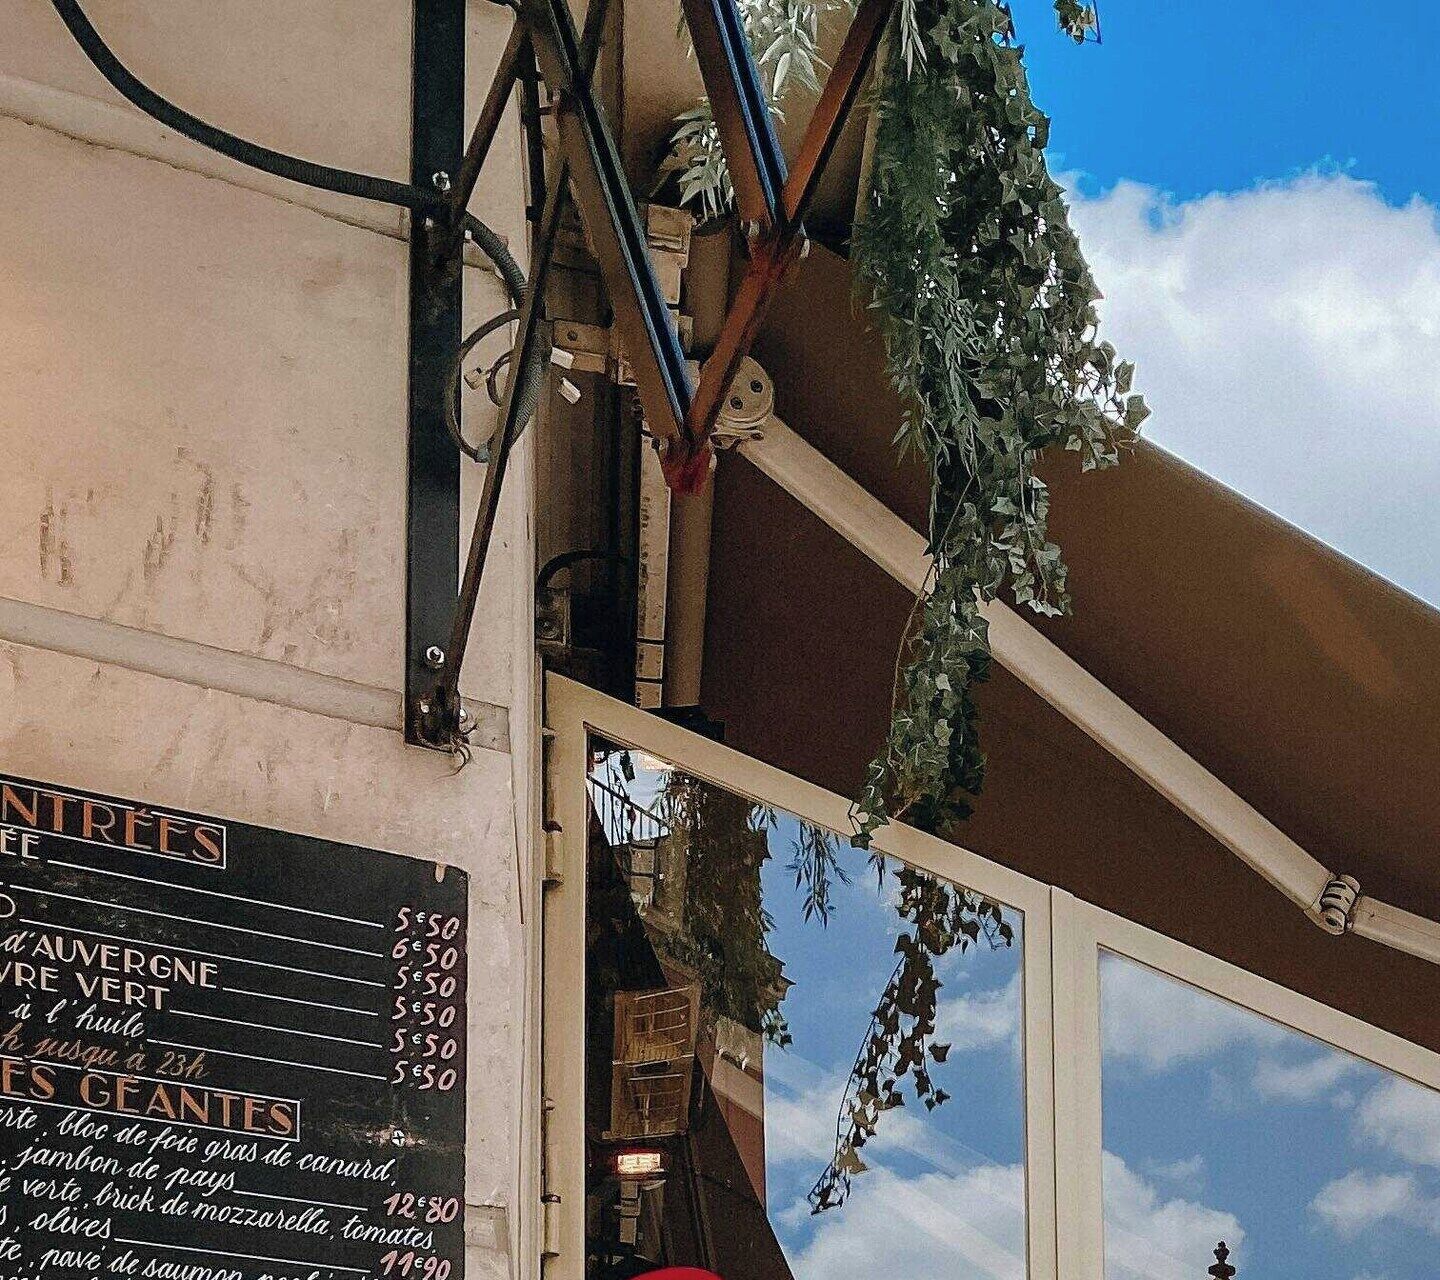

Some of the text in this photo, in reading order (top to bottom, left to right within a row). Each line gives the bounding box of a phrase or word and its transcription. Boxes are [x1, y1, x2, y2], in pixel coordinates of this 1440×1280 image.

[9, 993, 31, 1020] à
[75, 972, 170, 1010] VERT
[156, 1051, 209, 1079] 23h
[80, 1073, 294, 1135] GÉANTES
[57, 1110, 109, 1141] bloc
[113, 1123, 148, 1146] de
[149, 1126, 198, 1154] foie
[201, 1139, 257, 1163] gras
[261, 1143, 293, 1167] de
[12, 1138, 235, 1197] jambon de pays
[93, 1182, 154, 1212] brick
[160, 1193, 188, 1216] de
[29, 1207, 111, 1239] olives
[40, 1246, 106, 1271] pavé
[110, 1251, 140, 1274] de
